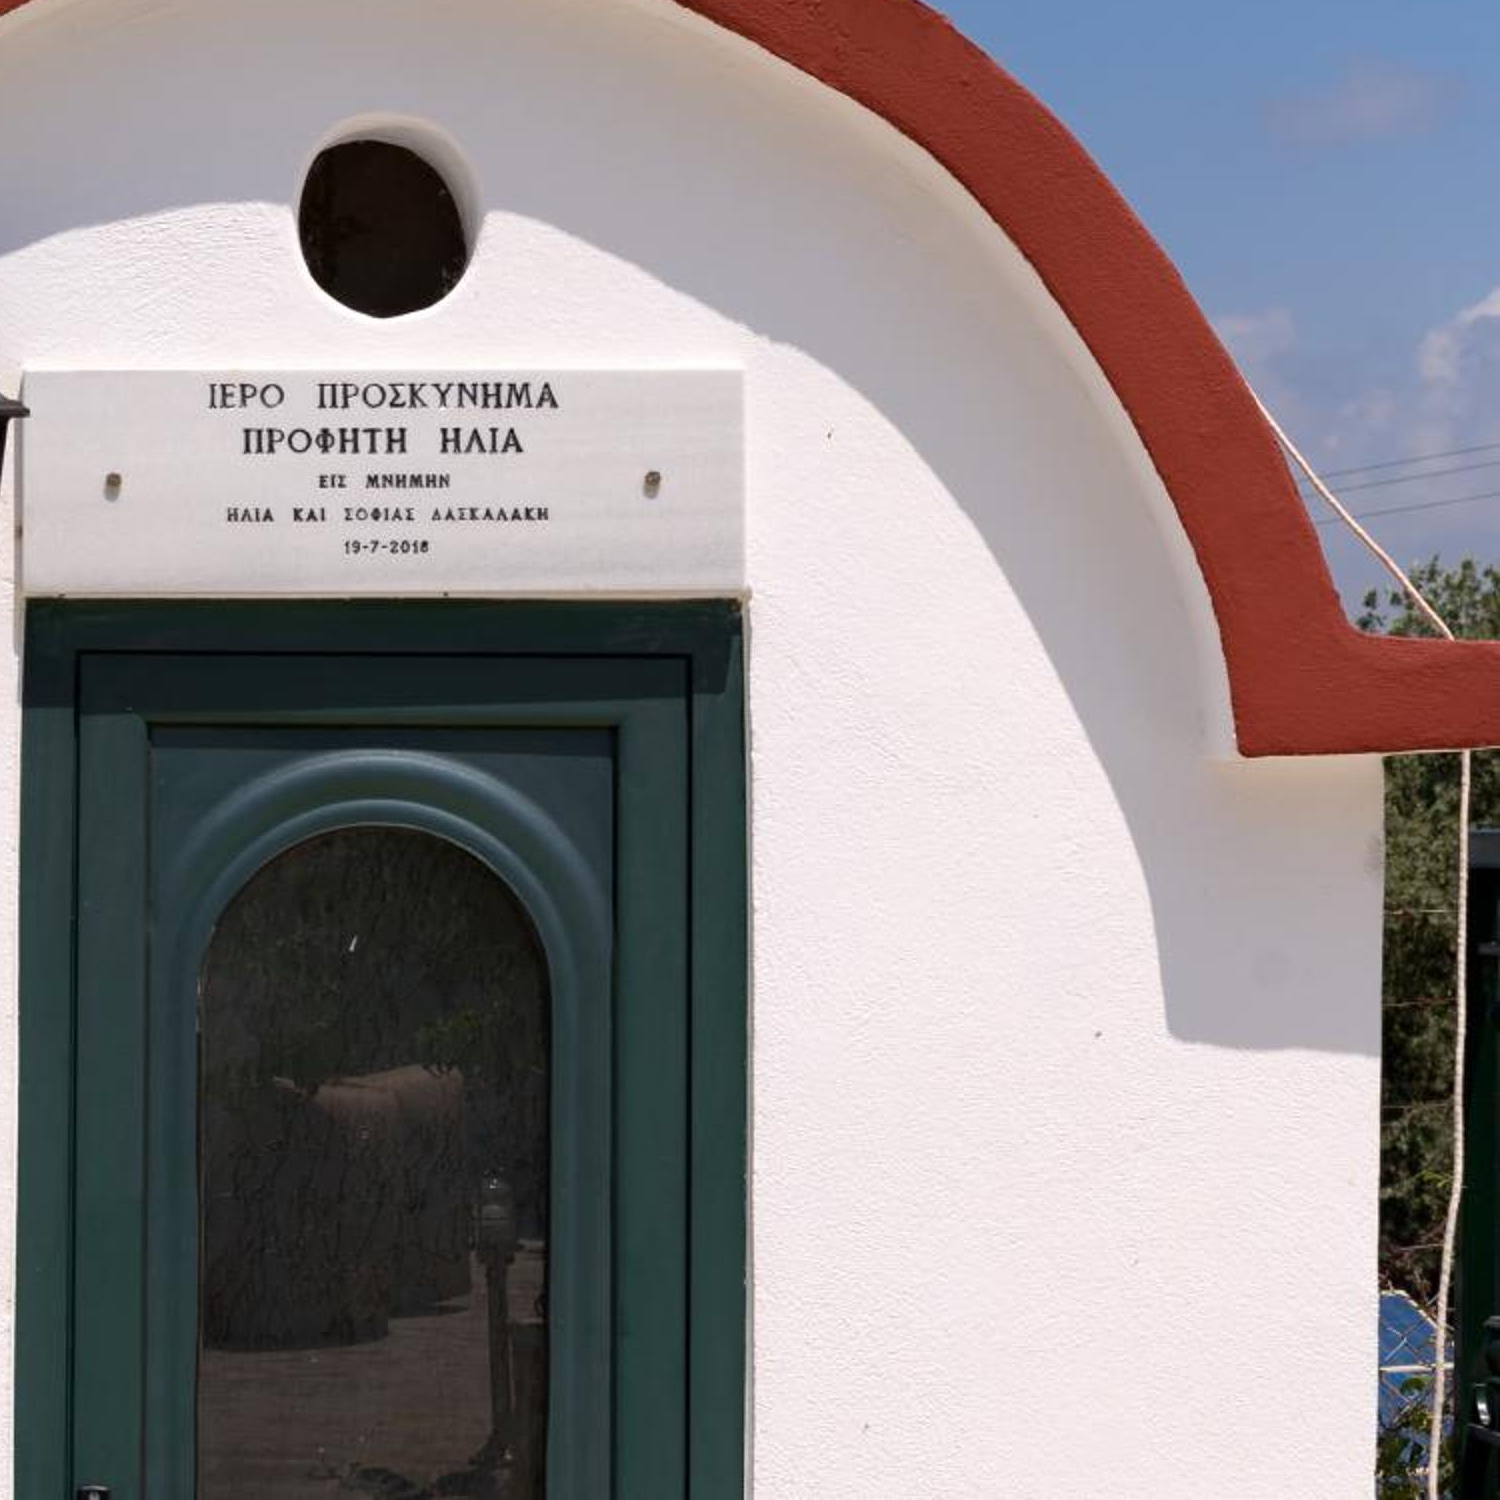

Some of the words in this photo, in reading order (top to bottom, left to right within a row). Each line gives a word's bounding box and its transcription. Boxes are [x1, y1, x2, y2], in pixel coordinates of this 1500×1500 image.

[210, 384, 285, 409] ΙΕΡΟ
[318, 383, 559, 409] ΠΡΟΣΚΥΝΗΜΑ
[243, 428, 407, 455] ΠΡΟΦΗΤΗ
[440, 428, 524, 454] ΗΛΙΑ
[319, 474, 347, 489] ΕΙΣ
[366, 474, 450, 489] ΜΝΗΜΗΝ
[227, 507, 274, 522] ΗΛΙΑ
[293, 507, 326, 522] ΚΑΙ
[344, 507, 415, 522] ΣΟΦΙΑΣ
[431, 507, 549, 522] ΔΑΣΚΑΛΑΚΗ
